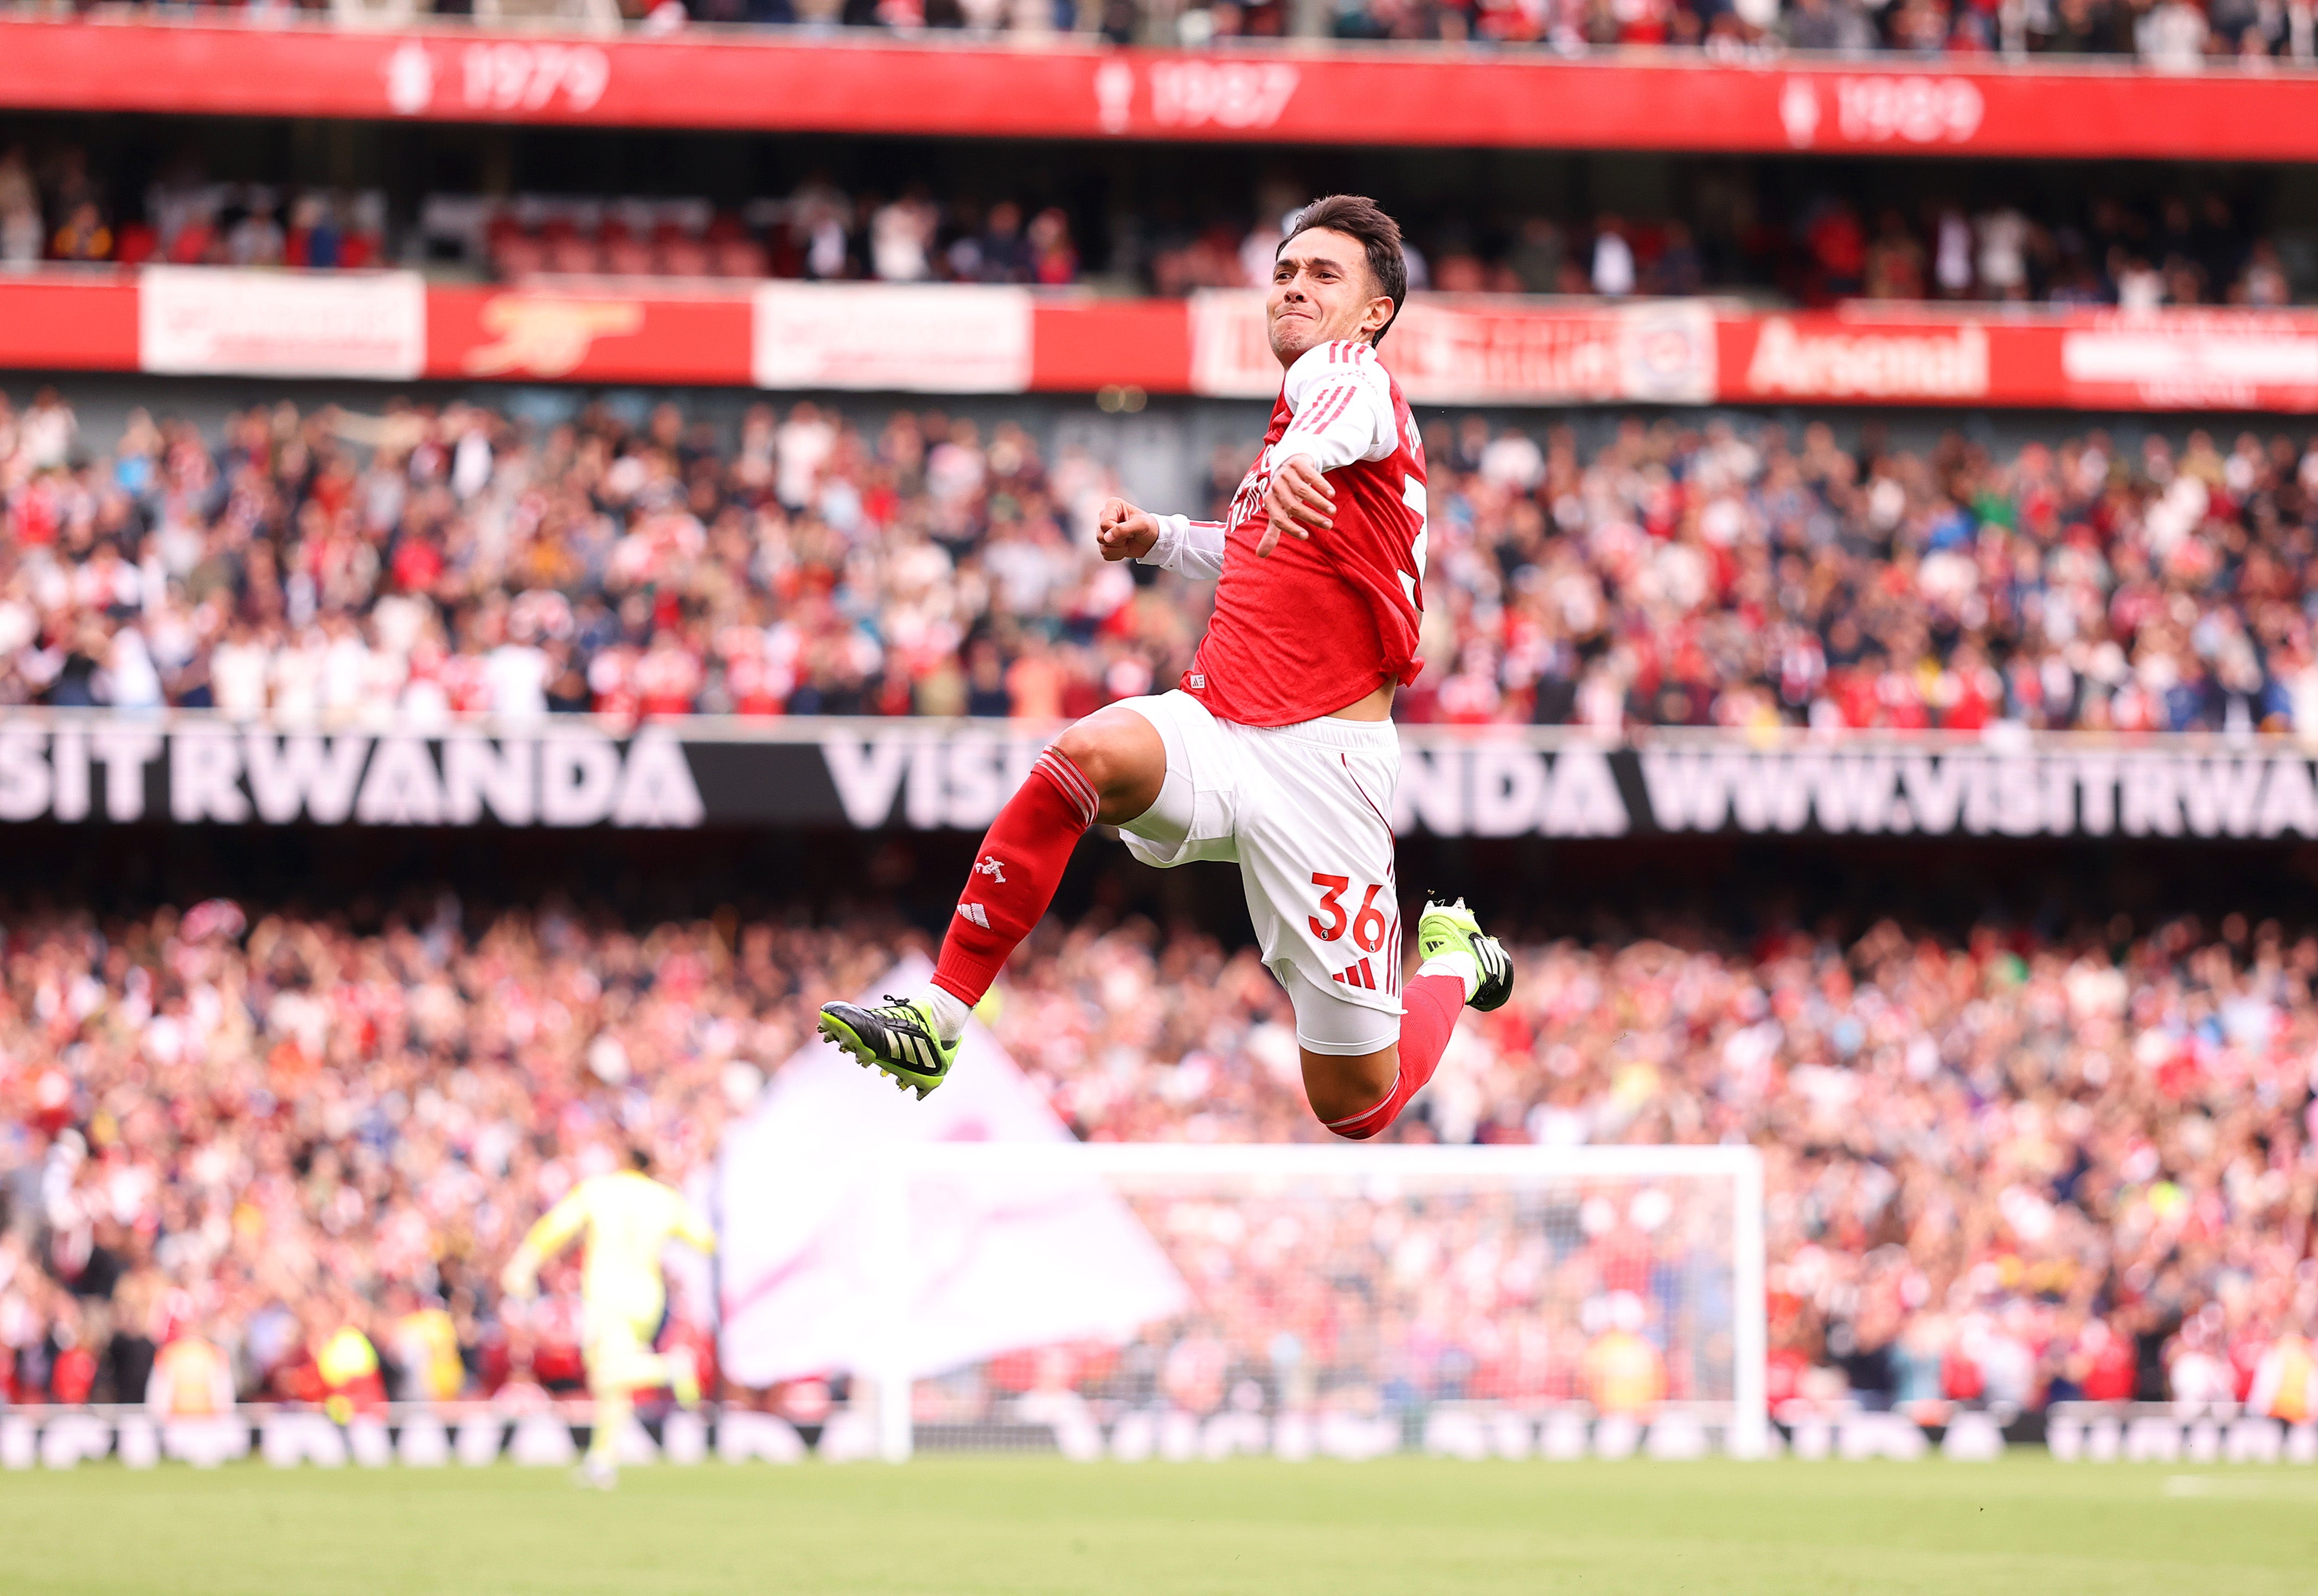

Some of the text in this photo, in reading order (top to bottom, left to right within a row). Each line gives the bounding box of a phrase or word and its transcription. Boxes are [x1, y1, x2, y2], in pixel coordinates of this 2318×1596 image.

[462, 41, 612, 112] 1979
[1149, 59, 1301, 129] 1987
[1836, 75, 1985, 143] 1989
[1308, 872, 1385, 952] 36
